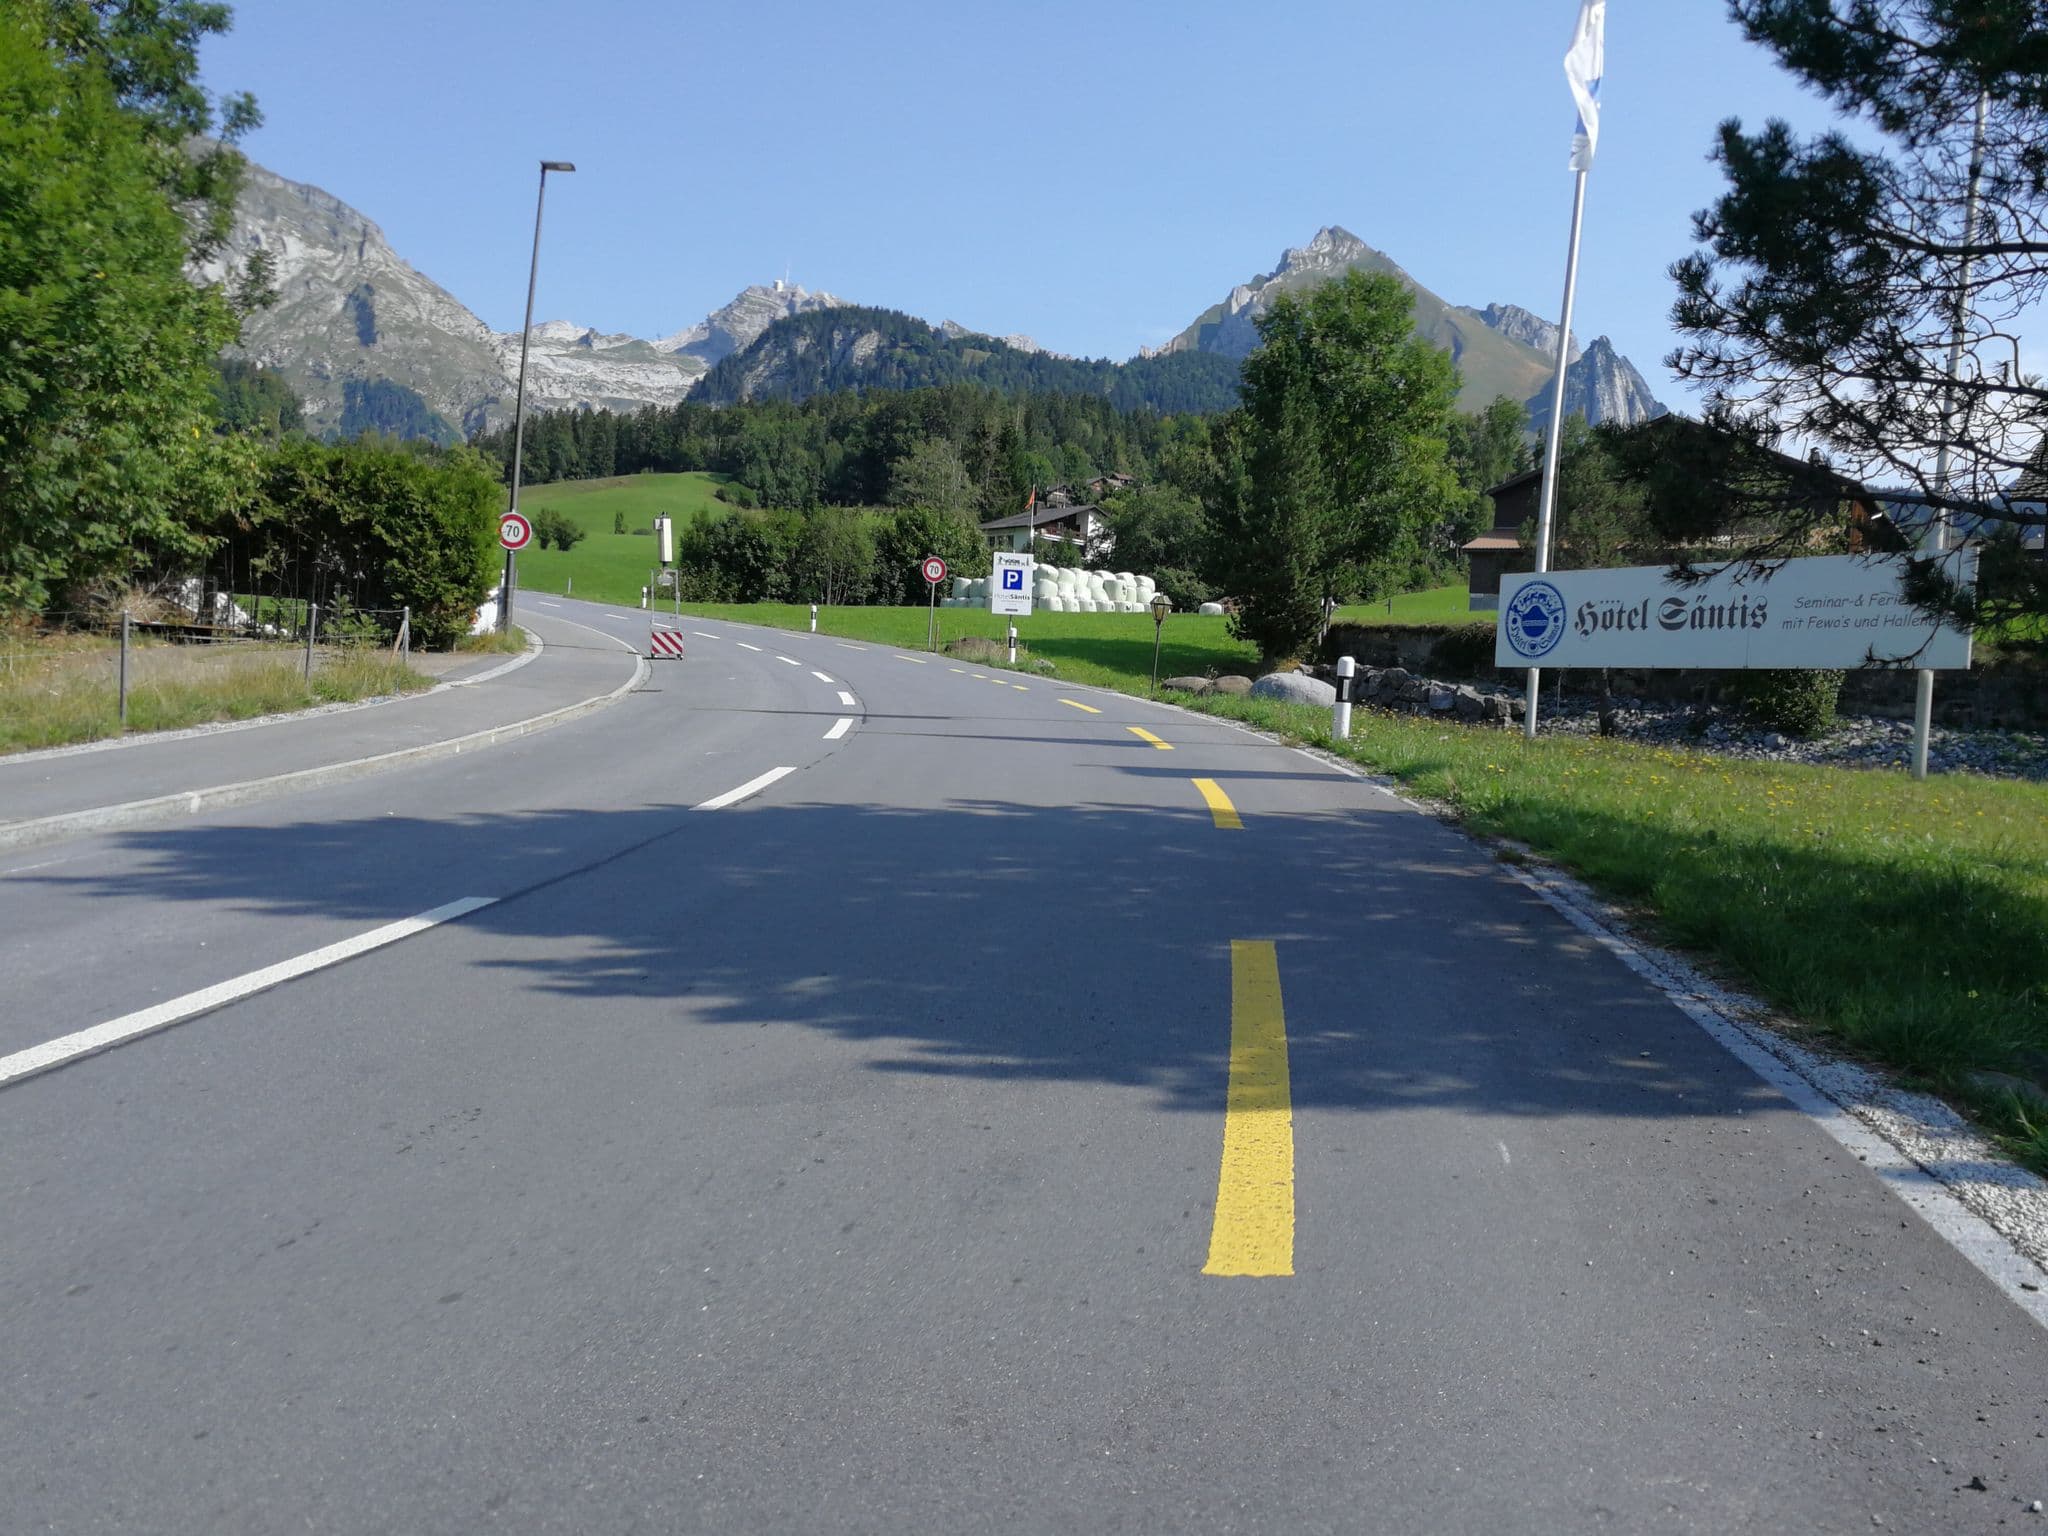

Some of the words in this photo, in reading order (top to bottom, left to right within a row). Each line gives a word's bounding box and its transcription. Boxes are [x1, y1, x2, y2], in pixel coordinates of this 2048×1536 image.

[506, 525, 520, 538] 70
[929, 565, 940, 575] 70
[1006, 571, 1019, 588] P
[1657, 594, 1768, 631] Säntis
[1782, 617, 1804, 630] mit
[1854, 614, 1879, 628] und
